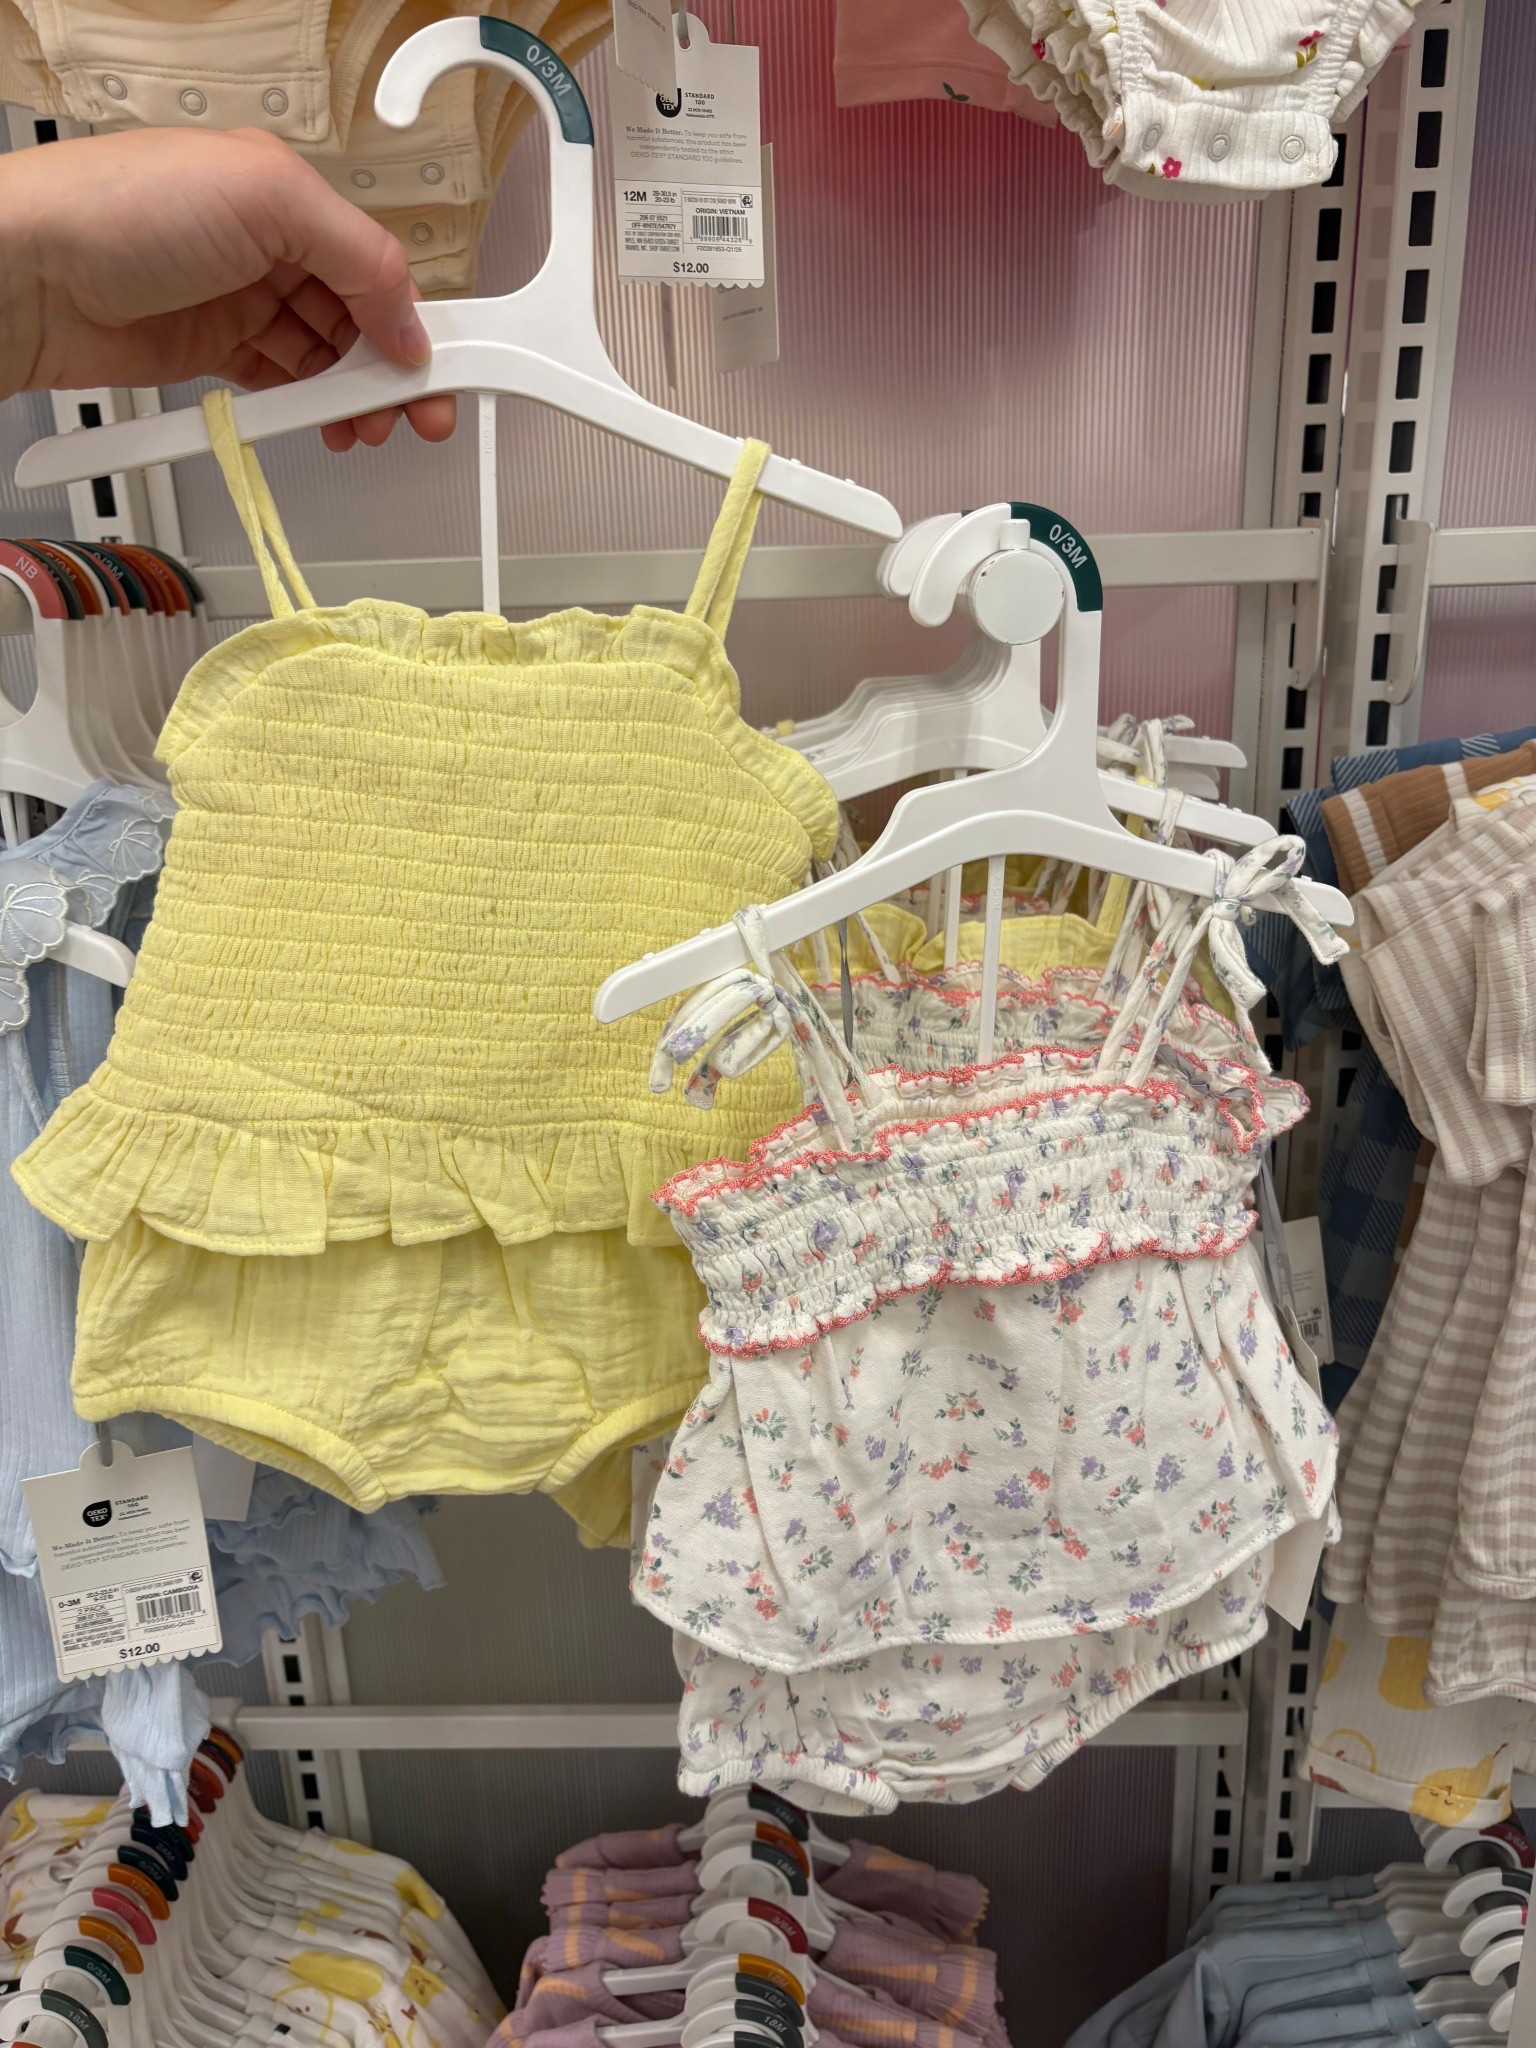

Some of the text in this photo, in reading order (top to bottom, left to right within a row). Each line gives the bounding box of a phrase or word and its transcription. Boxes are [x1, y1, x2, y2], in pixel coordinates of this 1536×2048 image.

[527, 44, 572, 97] 0/3M
[685, 92, 715, 100] STANDARD
[637, 126, 655, 134] Made
[662, 128, 683, 136] Better.
[684, 129, 692, 137] To
[624, 190, 647, 202] 12M
[696, 207, 746, 216] ORIGIN: VIETNAM
[673, 261, 710, 274] $12.00
[1049, 524, 1088, 569] 0/3M
[15, 556, 38, 579] NB
[87, 1507, 108, 1517] OEKO
[163, 1584, 199, 1596] CAMBODIA
[59, 1598, 81, 1609] 0-3M
[84, 1603, 106, 1612] PACK
[119, 1642, 160, 1659] $12.00
[87, 1962, 112, 1984] 0/3M
[70, 2010, 89, 2031] 18M
[764, 2015, 788, 2034] 18M
